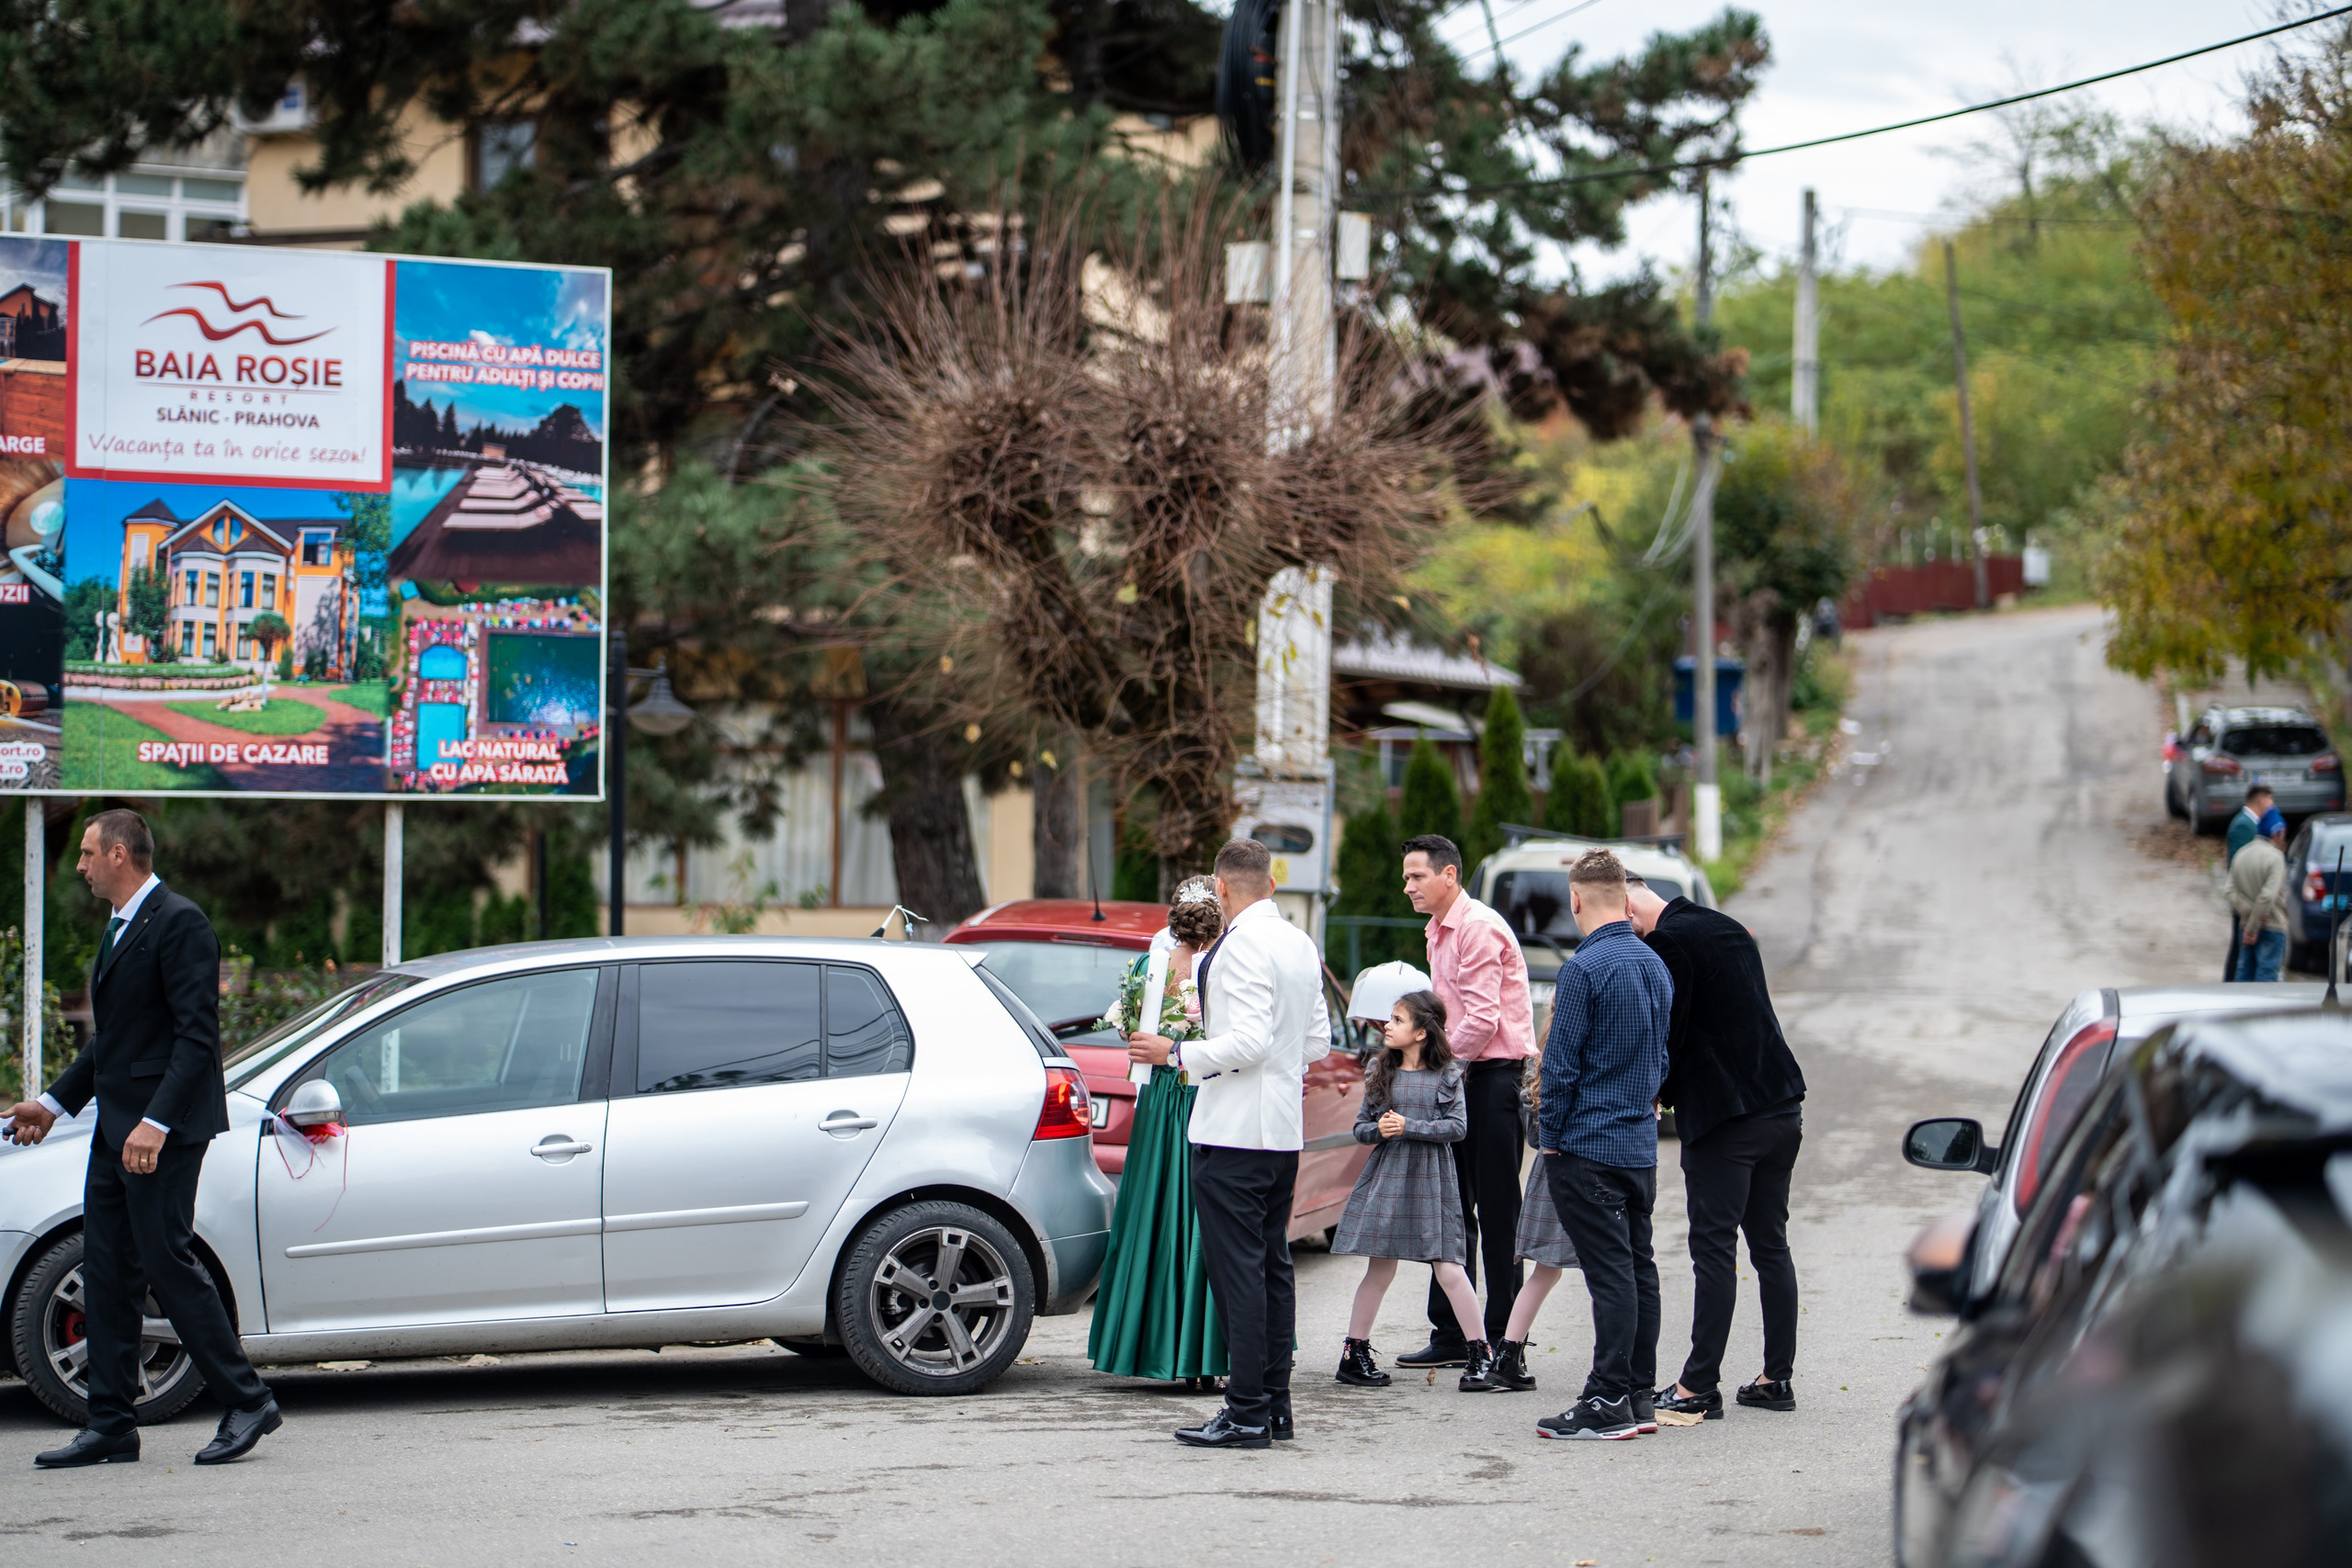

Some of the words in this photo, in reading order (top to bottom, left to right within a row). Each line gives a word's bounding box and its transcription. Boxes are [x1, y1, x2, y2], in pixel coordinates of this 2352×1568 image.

[135, 348, 222, 381] BAIA
[410, 340, 481, 361] PISCINĂ
[481, 344, 505, 364] CU
[508, 344, 544, 367] APĂ
[546, 348, 601, 368] DULCE
[405, 362, 473, 383] PENTRU
[190, 390, 288, 404] RESORT
[156, 405, 220, 424] SLĂNIC
[235, 412, 320, 429] PRAHOVA
[194, 439, 215, 457] ta
[223, 438, 243, 457] în
[252, 440, 300, 461] orice
[209, 743, 240, 763] DE
[243, 744, 329, 765] CAZARE
[439, 739, 476, 759] LAC
[478, 740, 561, 761] NATURAL
[430, 761, 458, 782] CU
[459, 761, 497, 782] APĂ
[499, 761, 570, 784] SĂRATĂ
